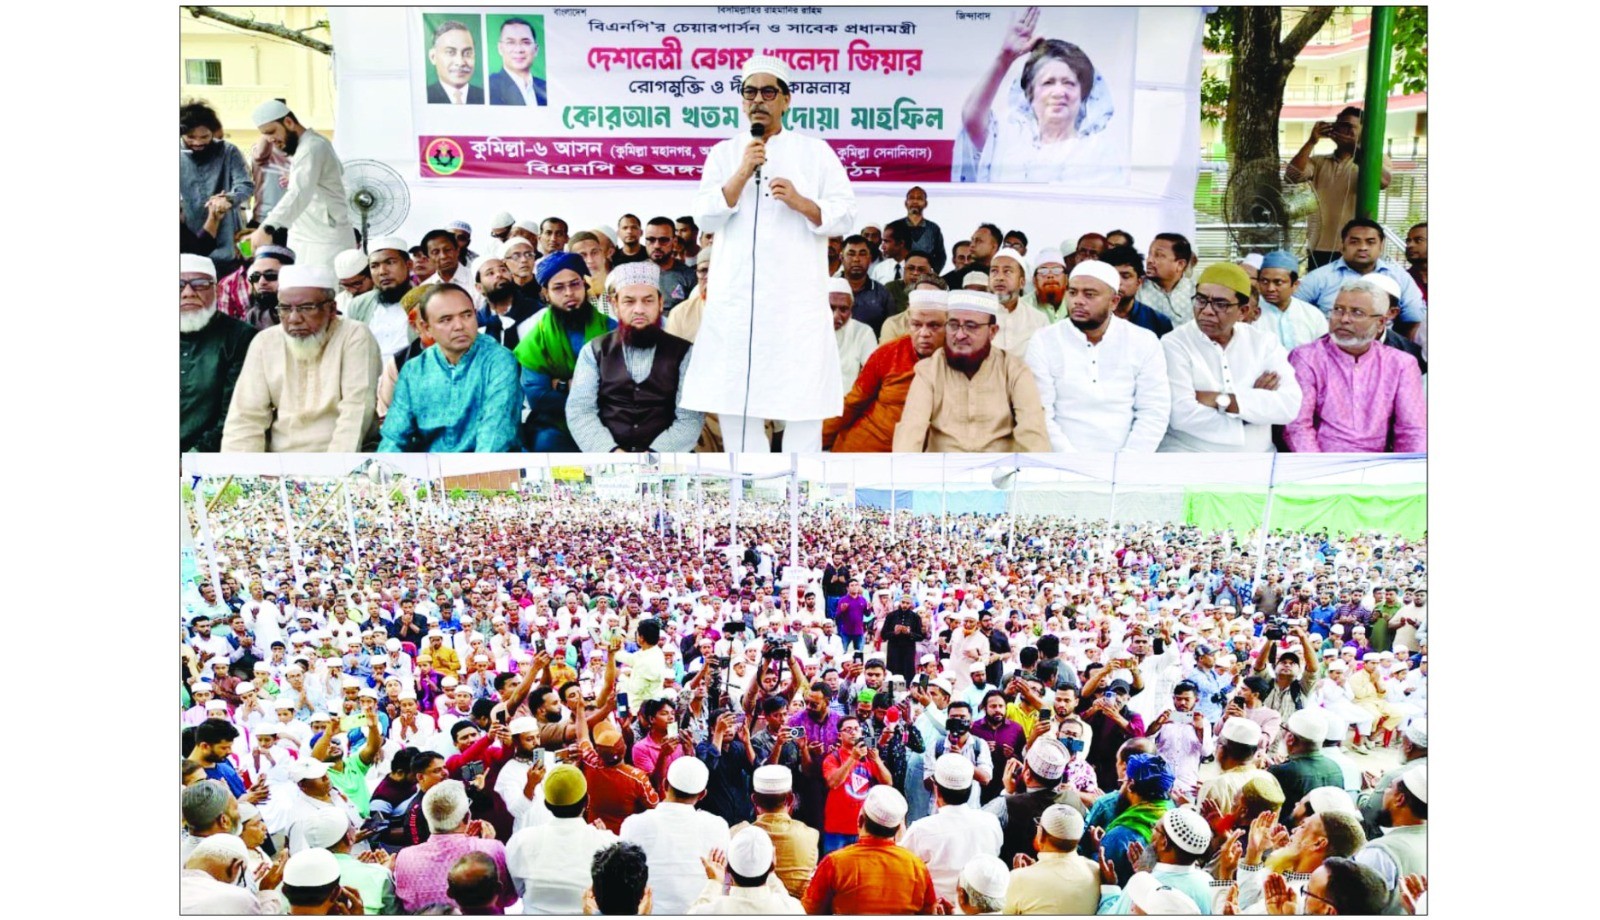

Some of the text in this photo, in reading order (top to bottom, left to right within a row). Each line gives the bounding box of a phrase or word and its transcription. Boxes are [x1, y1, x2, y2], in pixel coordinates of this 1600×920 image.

[673, 20, 760, 33] চেয়ারপার্সন
[767, 24, 781, 33] ও
[787, 23, 839, 34] সাবেক
[587, 36, 683, 72] দেশনেত্রী
[847, 38, 923, 76] জিয়ার
[628, 75, 706, 98] রোগমুক্তি
[711, 81, 724, 94] ও
[562, 105, 671, 131] কোরআন
[682, 106, 739, 129] খতম
[850, 97, 944, 131] মাহফিল
[552, 141, 603, 158] আসন
[526, 160, 615, 176] বিএনপি
[625, 165, 645, 175] ও
